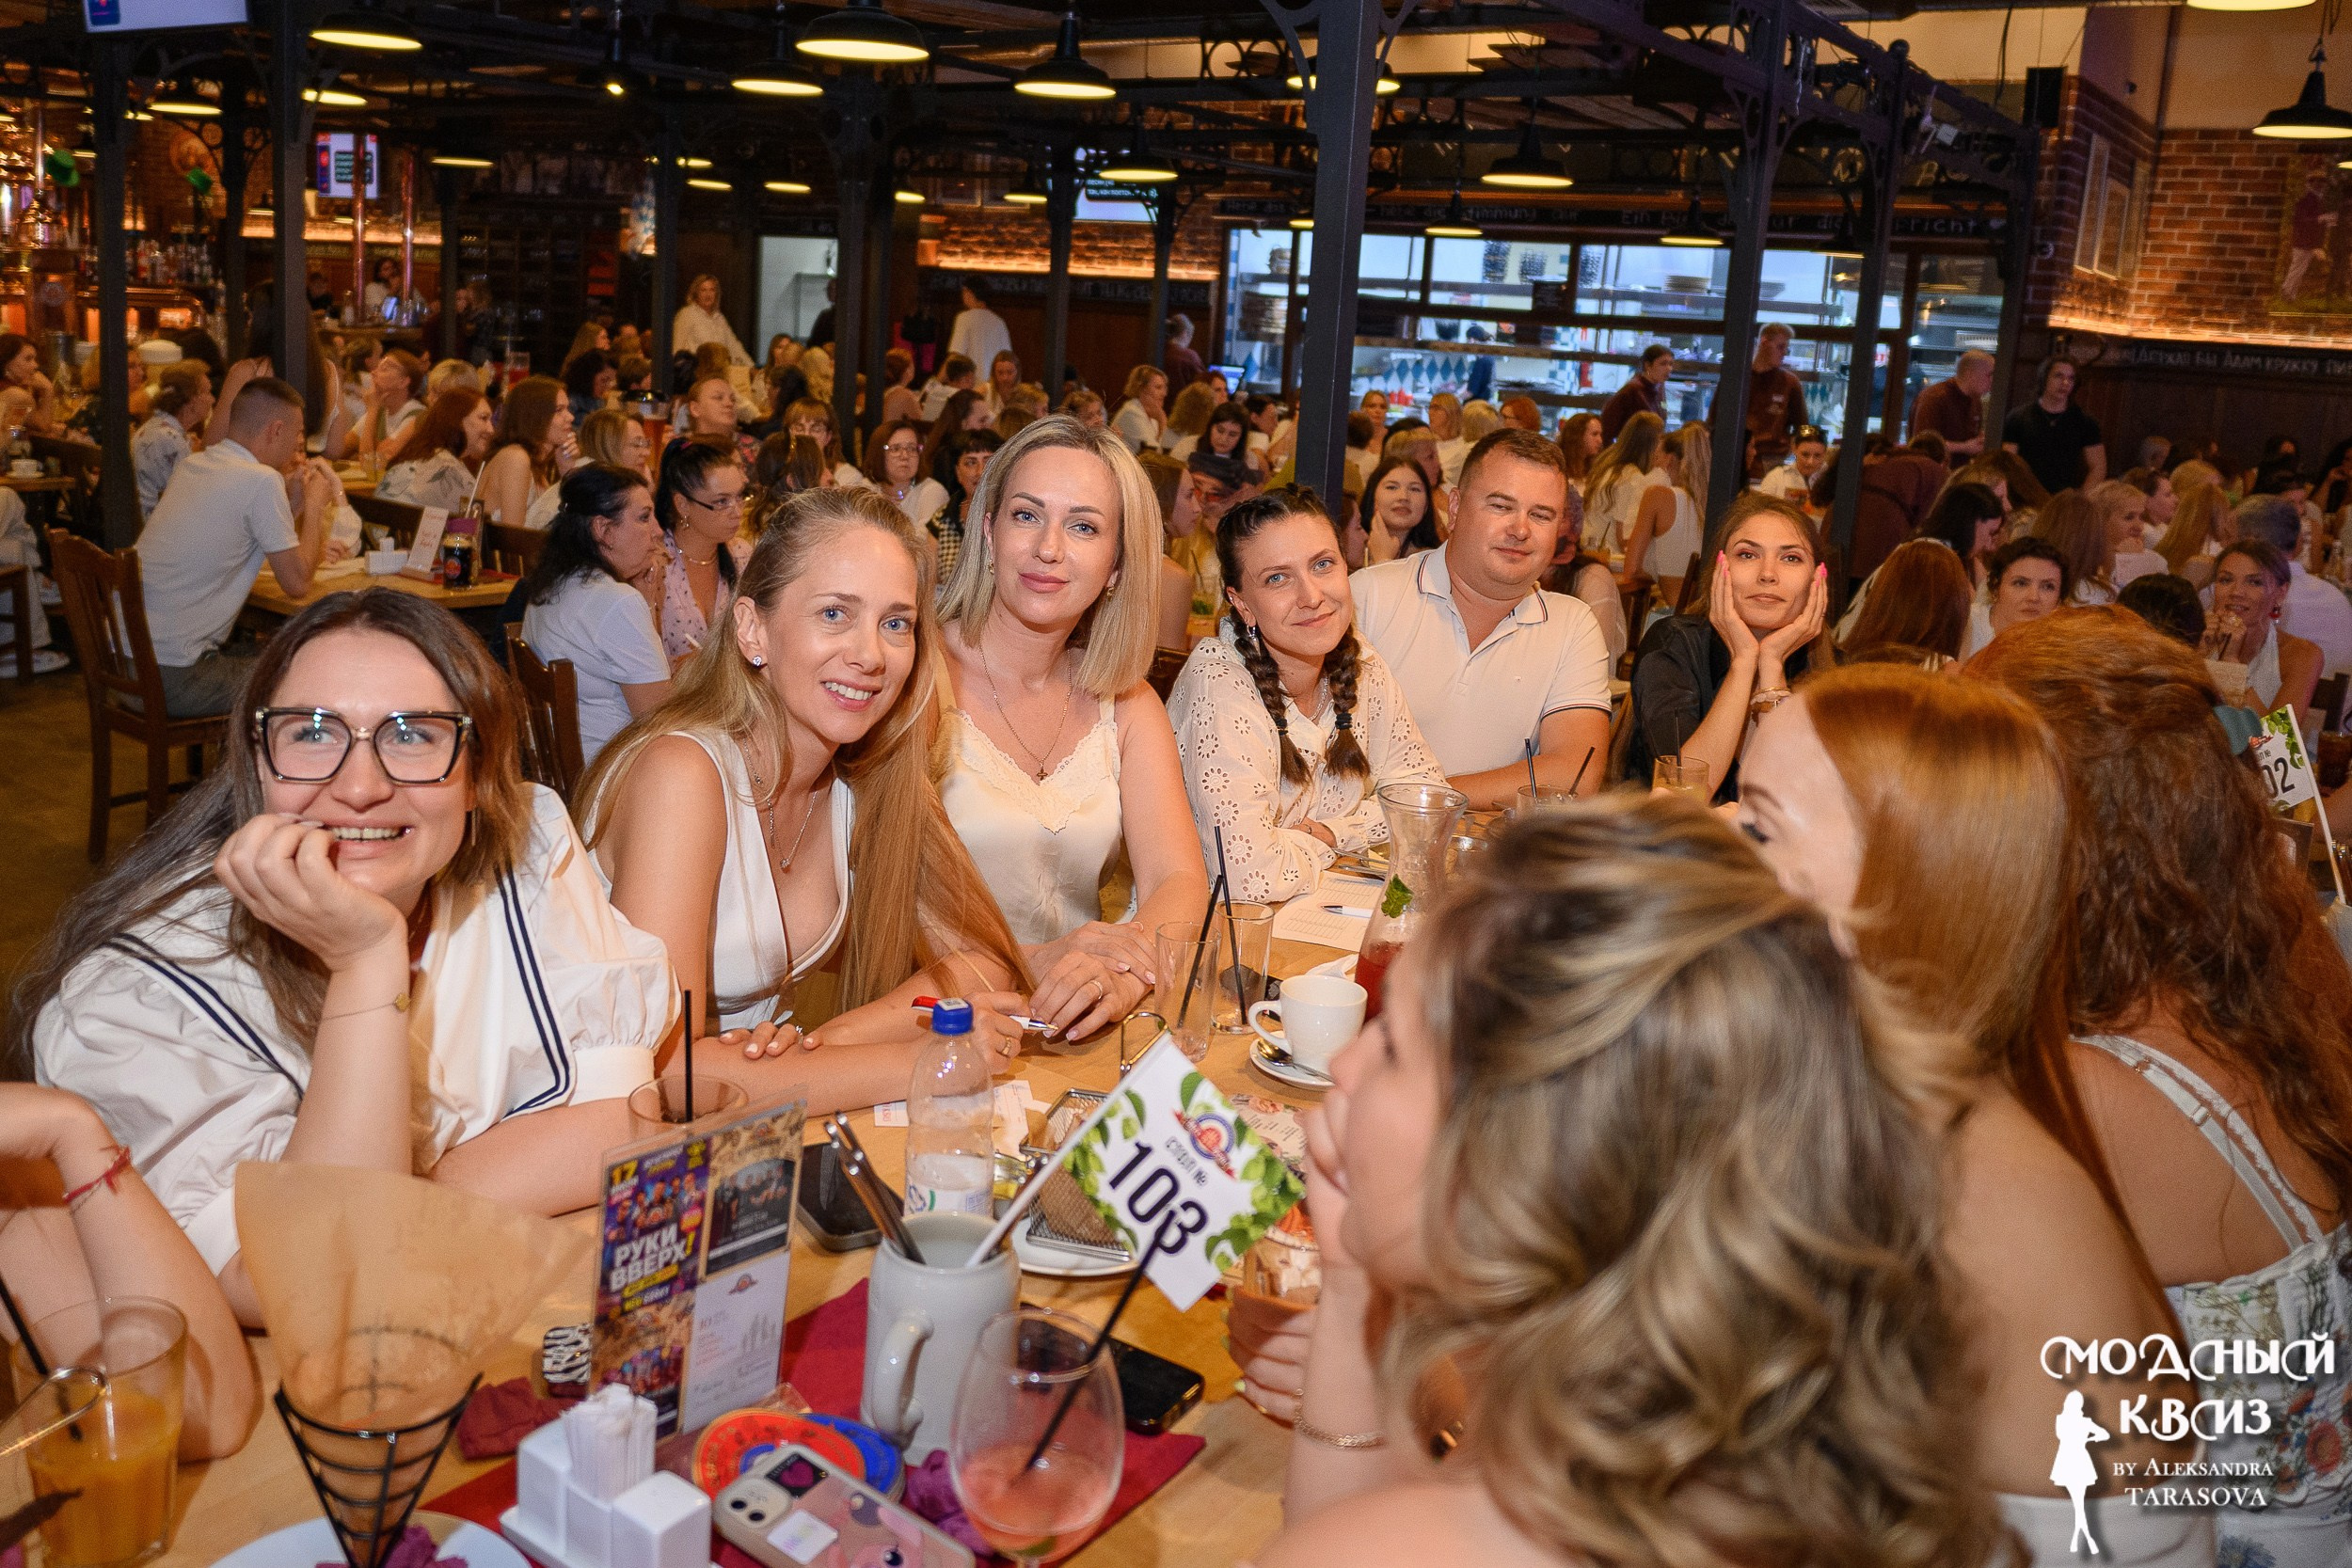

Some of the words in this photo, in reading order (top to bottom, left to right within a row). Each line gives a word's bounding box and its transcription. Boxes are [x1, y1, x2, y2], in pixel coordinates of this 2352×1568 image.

[612, 1161, 638, 1186] 17
[1109, 1140, 1209, 1255] 103
[614, 1224, 678, 1269] РУКИ
